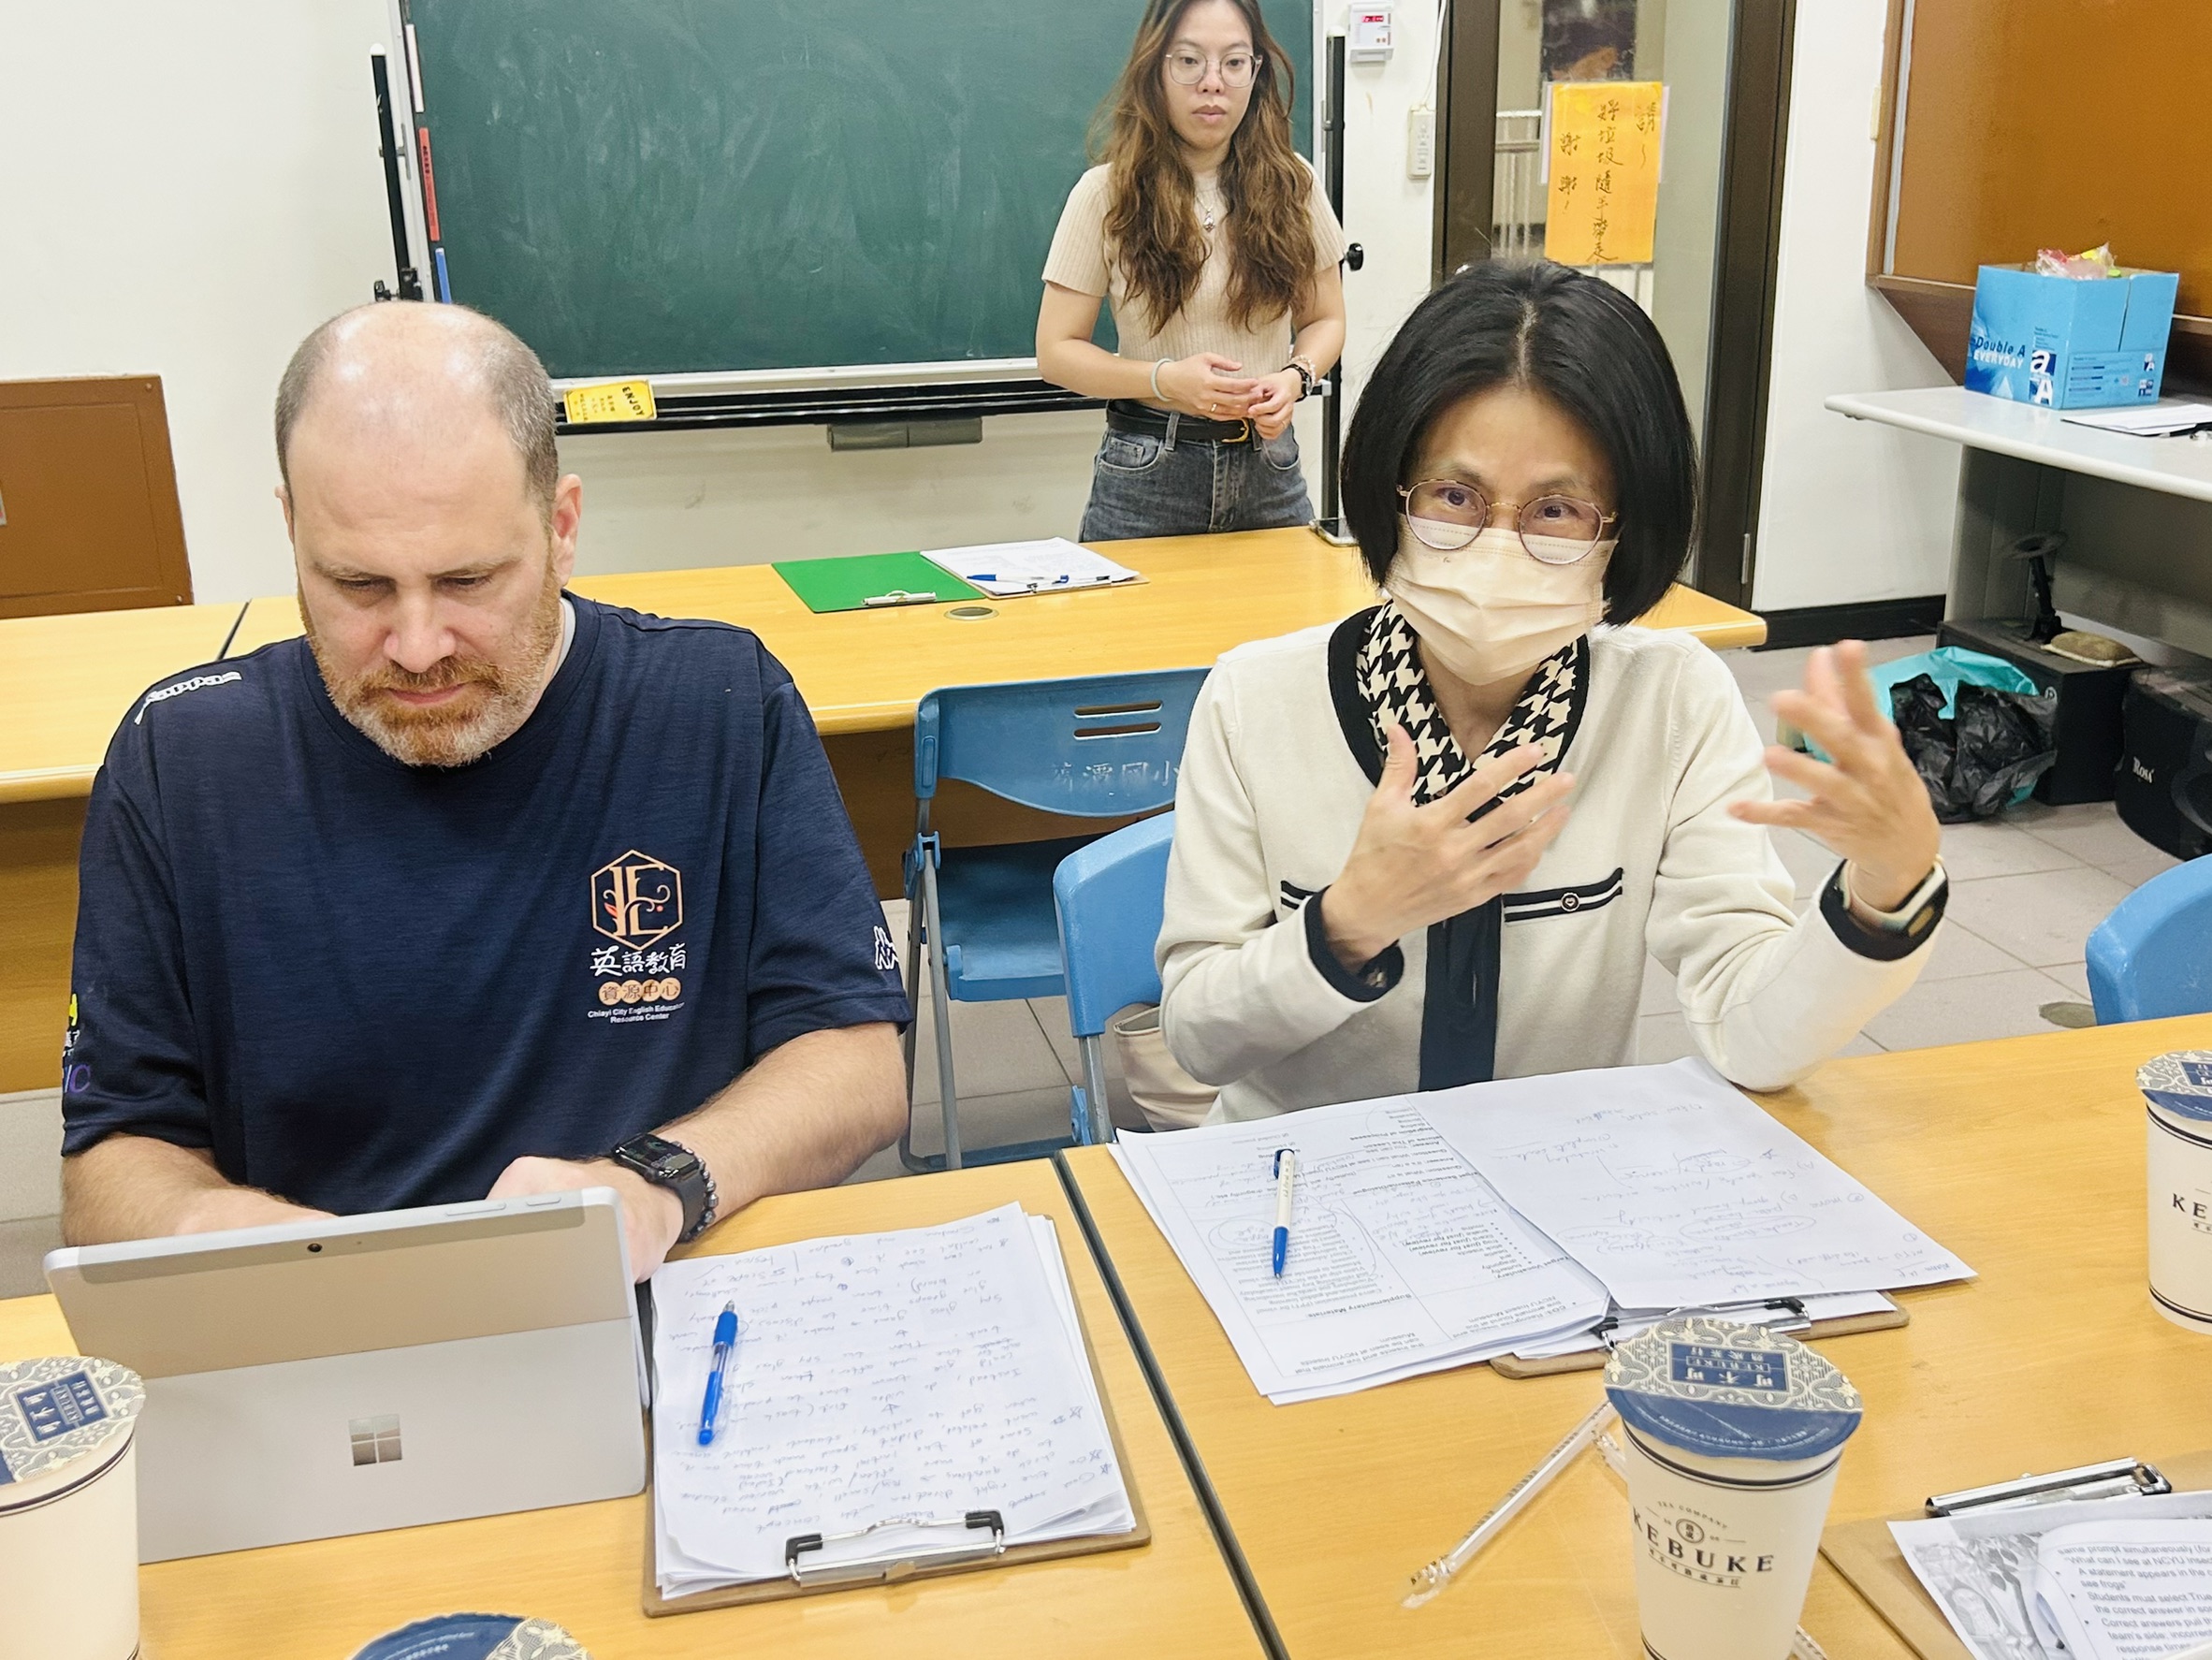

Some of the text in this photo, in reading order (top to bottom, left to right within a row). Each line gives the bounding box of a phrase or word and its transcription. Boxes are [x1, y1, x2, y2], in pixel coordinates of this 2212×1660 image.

[1975, 336, 2027, 357] Double A
[1973, 352, 2024, 370] EVERYDAY
[622, 386, 645, 416] ENJOY
[589, 943, 687, 977] 英語教育
[602, 981, 680, 1002] 資源中心
[588, 1010, 612, 1019] Chiayi
[613, 1008, 628, 1016] City
[629, 1005, 654, 1014] English
[610, 1012, 670, 1024] Resource Center
[1349, 1294, 1411, 1309] Supplementary
[1470, 1296, 1556, 1322] NCYU Insect Museum
[1381, 1332, 1415, 1342] Museum
[1332, 1352, 1358, 1361] NCYU
[1678, 1504, 1728, 1529] COMPANY
[1633, 1506, 1774, 1573] KEBUKE
[2088, 1546, 2120, 1554] prompt
[2123, 1545, 2192, 1554] simultaneously
[2152, 1557, 2184, 1565] NCYU
[2089, 1568, 2135, 1577] statement
[2138, 1569, 2176, 1579] appears
[2088, 1592, 2131, 1602] Students
[2159, 1594, 2188, 1602] select
[2095, 1605, 2110, 1613] the
[2102, 1617, 2202, 1627] Correct answers pull
[2117, 1643, 2163, 1653] response
